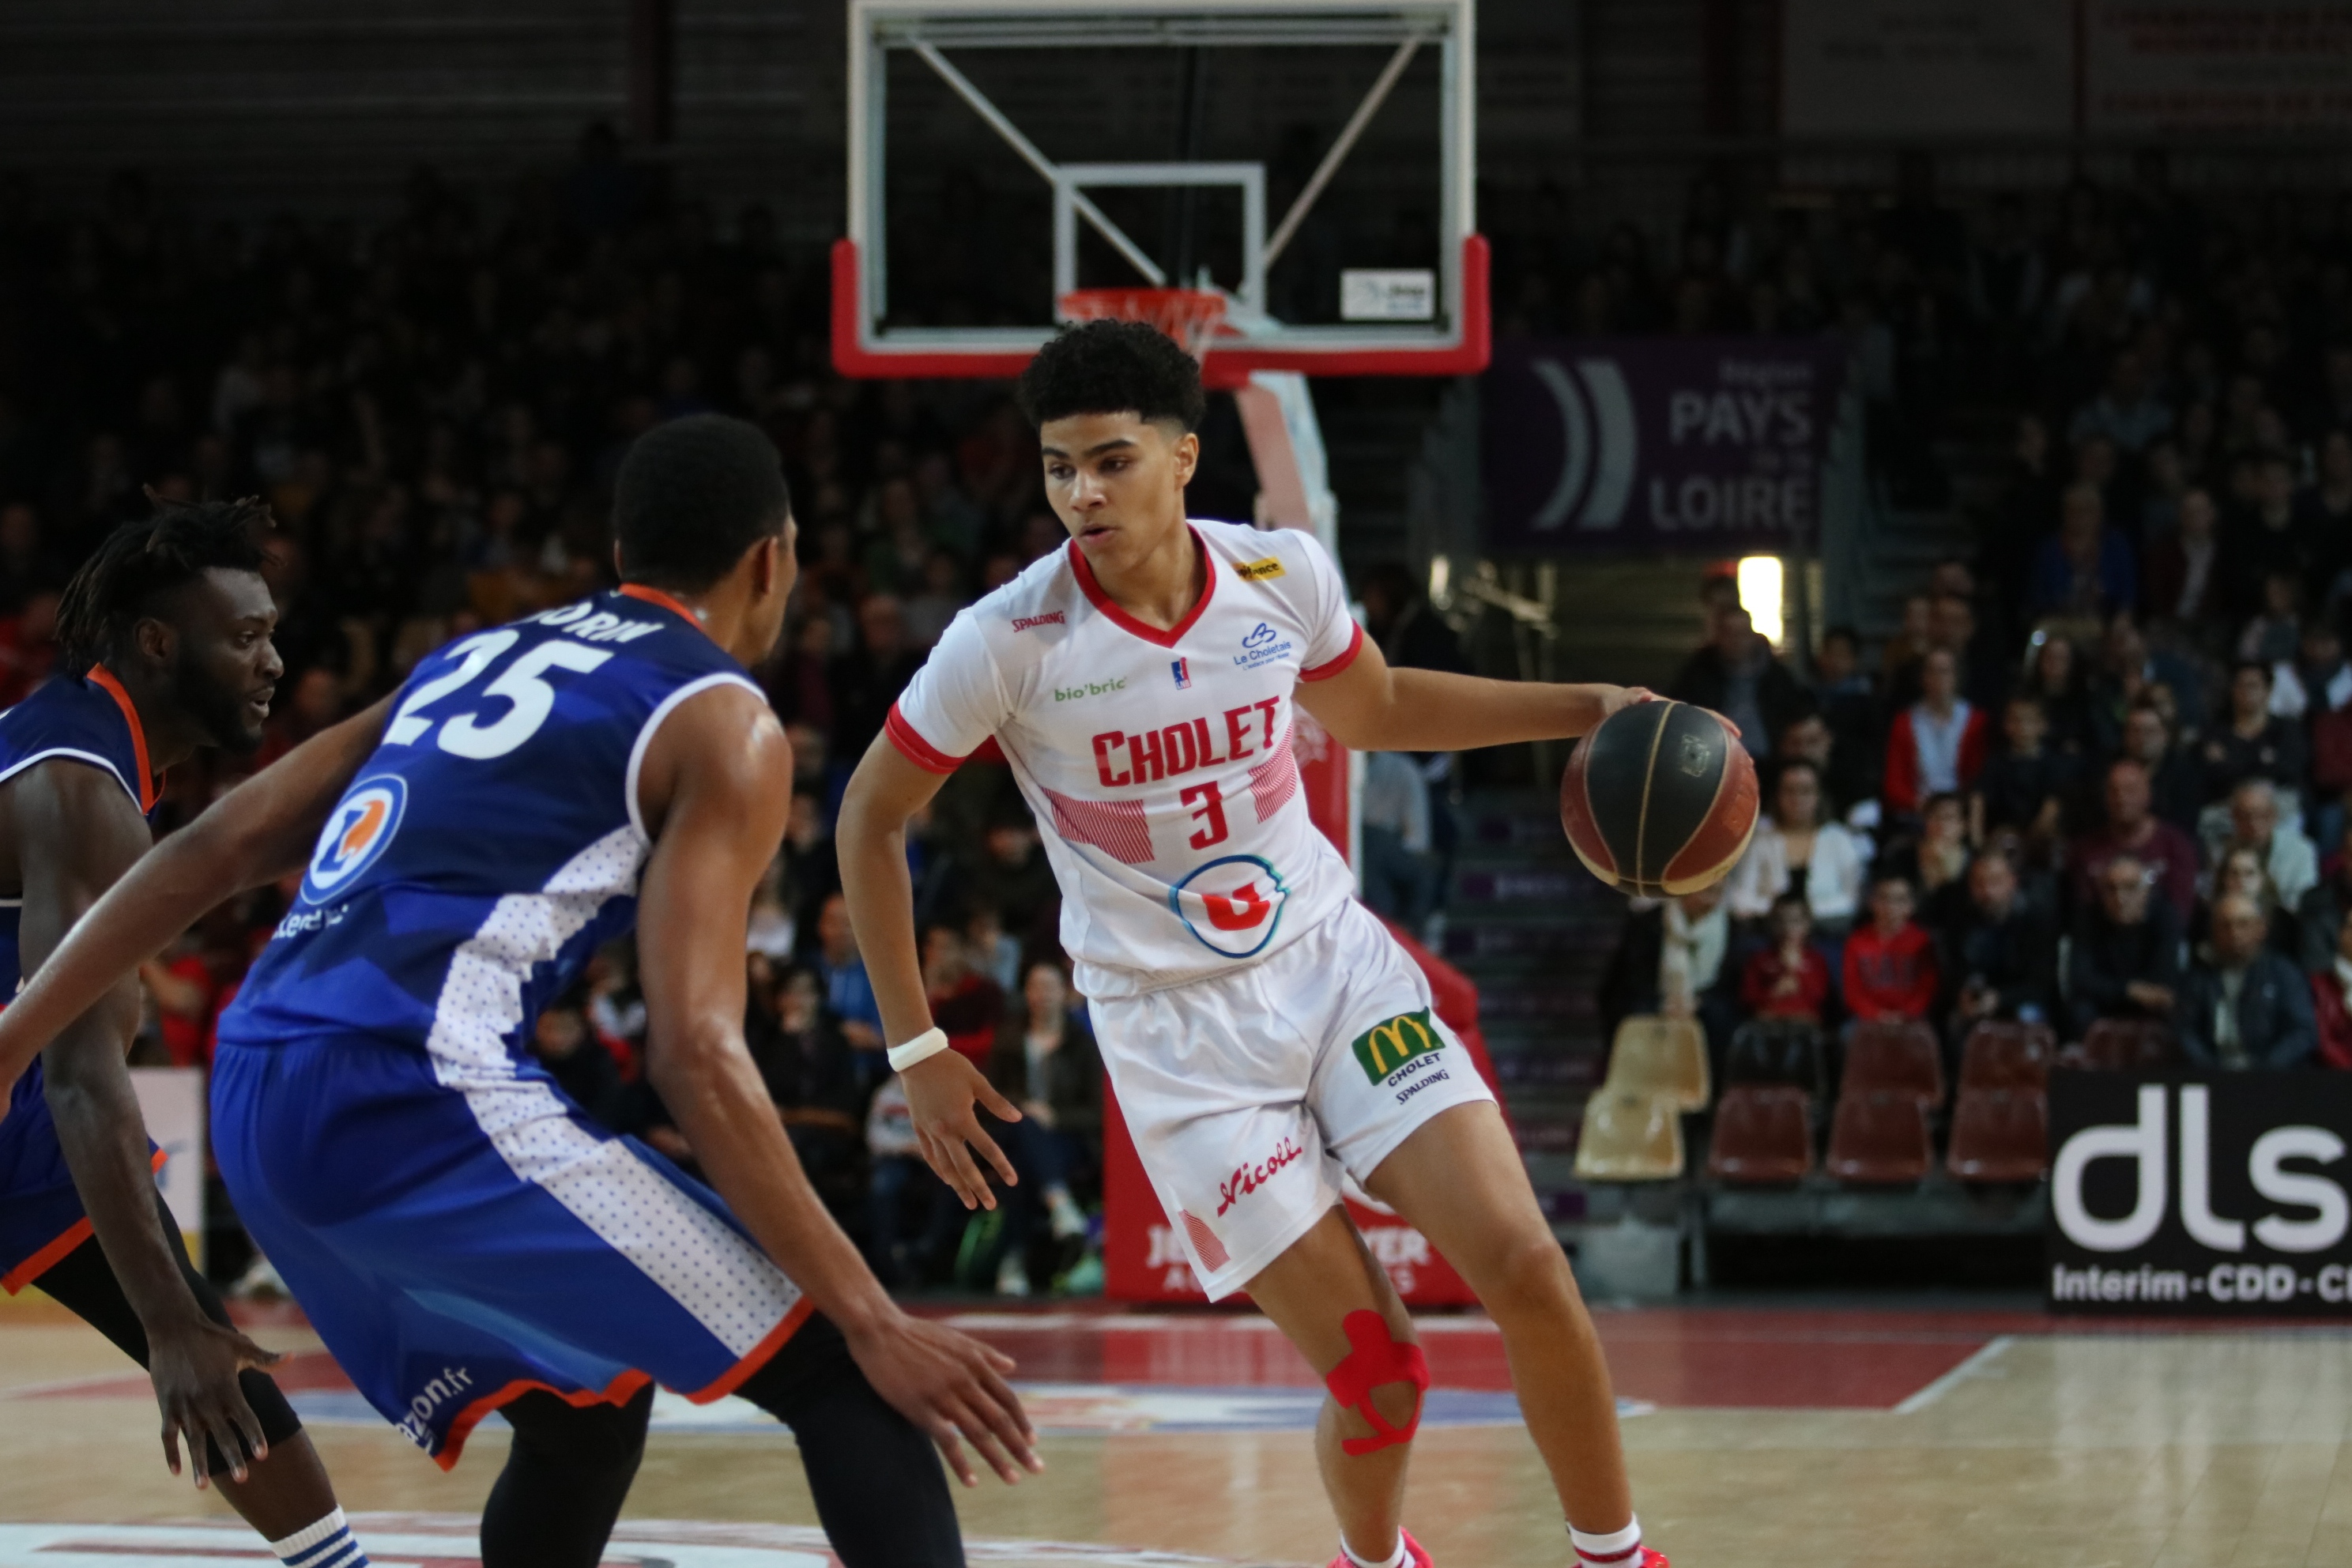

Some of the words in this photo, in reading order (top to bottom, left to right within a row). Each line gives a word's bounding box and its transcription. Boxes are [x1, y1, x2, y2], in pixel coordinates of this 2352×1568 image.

[1668, 390, 1815, 448] PAYS
[1649, 474, 1813, 533] LOIRE
[1012, 610, 1066, 633] SPALDING
[1233, 654, 1248, 665] Le
[1250, 640, 1291, 661] Choletais
[381, 629, 615, 760] 25
[1092, 695, 1280, 788] CHOLET
[1179, 780, 1229, 850] 3
[1388, 1053, 1442, 1087] CHOLET
[1396, 1069, 1449, 1106] SPALDING
[1217, 1136, 1303, 1217] Nicoll
[2052, 1083, 2352, 1253] dls
